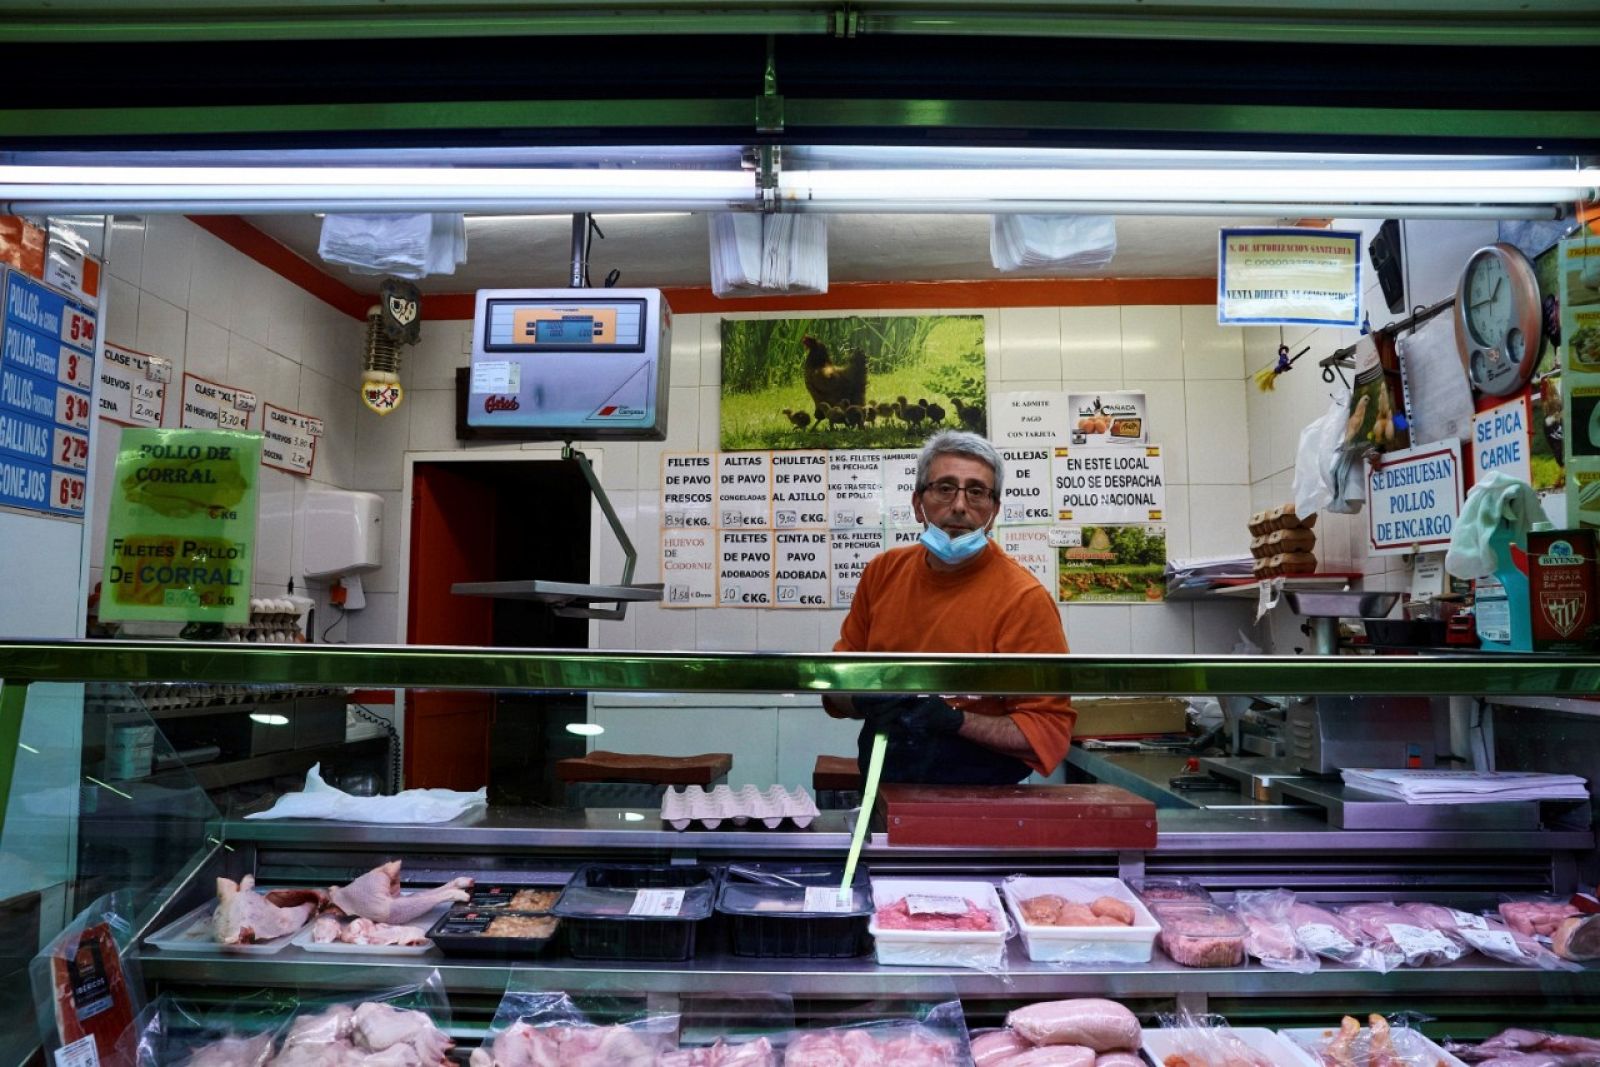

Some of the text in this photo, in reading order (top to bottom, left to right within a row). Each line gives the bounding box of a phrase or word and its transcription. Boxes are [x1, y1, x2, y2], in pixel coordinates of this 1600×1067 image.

[1227, 289, 1252, 300] VENTA
[9, 283, 40, 325] POLLOS
[5, 327, 36, 368] POLLOS
[104, 349, 131, 366] CLASE
[101, 374, 131, 391] HUEVOS
[2, 370, 33, 411] POLLOS
[194, 383, 216, 398] CLASE
[193, 406, 219, 420] HUEVOS
[271, 411, 288, 424] CLASE
[1477, 411, 1522, 443] SE PICA
[0, 414, 48, 459] GALLINAS
[142, 444, 233, 461] POLLO DE
[1002, 451, 1048, 461] OLLEJAS
[1480, 441, 1521, 470] CARNE
[668, 457, 710, 467] FILETES
[724, 457, 762, 466] ALITAS
[772, 456, 826, 465] CHULETAS
[851, 454, 881, 462] FILETES
[831, 463, 879, 471] DE PECHUGA
[1067, 457, 1149, 470] EN ESTE LOCAL
[136, 467, 217, 484] CORRAL
[904, 467, 917, 475] DE
[1016, 470, 1030, 480] DE
[1373, 459, 1453, 491] SE DESHUESAN
[666, 475, 711, 485] DE PAVO
[720, 474, 766, 484] DE PAVO
[776, 474, 822, 484] DE PAVO
[1056, 474, 1162, 489] SOLO SE DESPACHA
[897, 483, 916, 491] POL
[772, 492, 826, 502] AL AJILLO
[837, 492, 873, 500] DE POLLO
[1005, 488, 1040, 497] POLLO
[665, 493, 712, 503] FRESCOS
[1063, 493, 1157, 506] POLLO NACIONAL
[1390, 489, 1436, 514] POLLOS
[1377, 514, 1452, 541] DE ENCARGO
[724, 534, 767, 543] FILETES
[777, 533, 826, 543] CINTA DE
[852, 532, 882, 541] FILETES
[1006, 532, 1047, 541] HUEVOS
[664, 538, 705, 547] HUEVOS
[832, 541, 881, 549] DE PECHUGA
[1006, 543, 1020, 552] DE
[664, 549, 677, 557] DE
[724, 552, 770, 562] DE PAVO
[787, 552, 816, 561] PAVO
[1013, 554, 1047, 563] ORRAL
[138, 566, 240, 586] CORRAL
[721, 570, 770, 579] ADOBADOS
[776, 570, 827, 580] ADOBADA
[838, 571, 863, 579] DE PO
